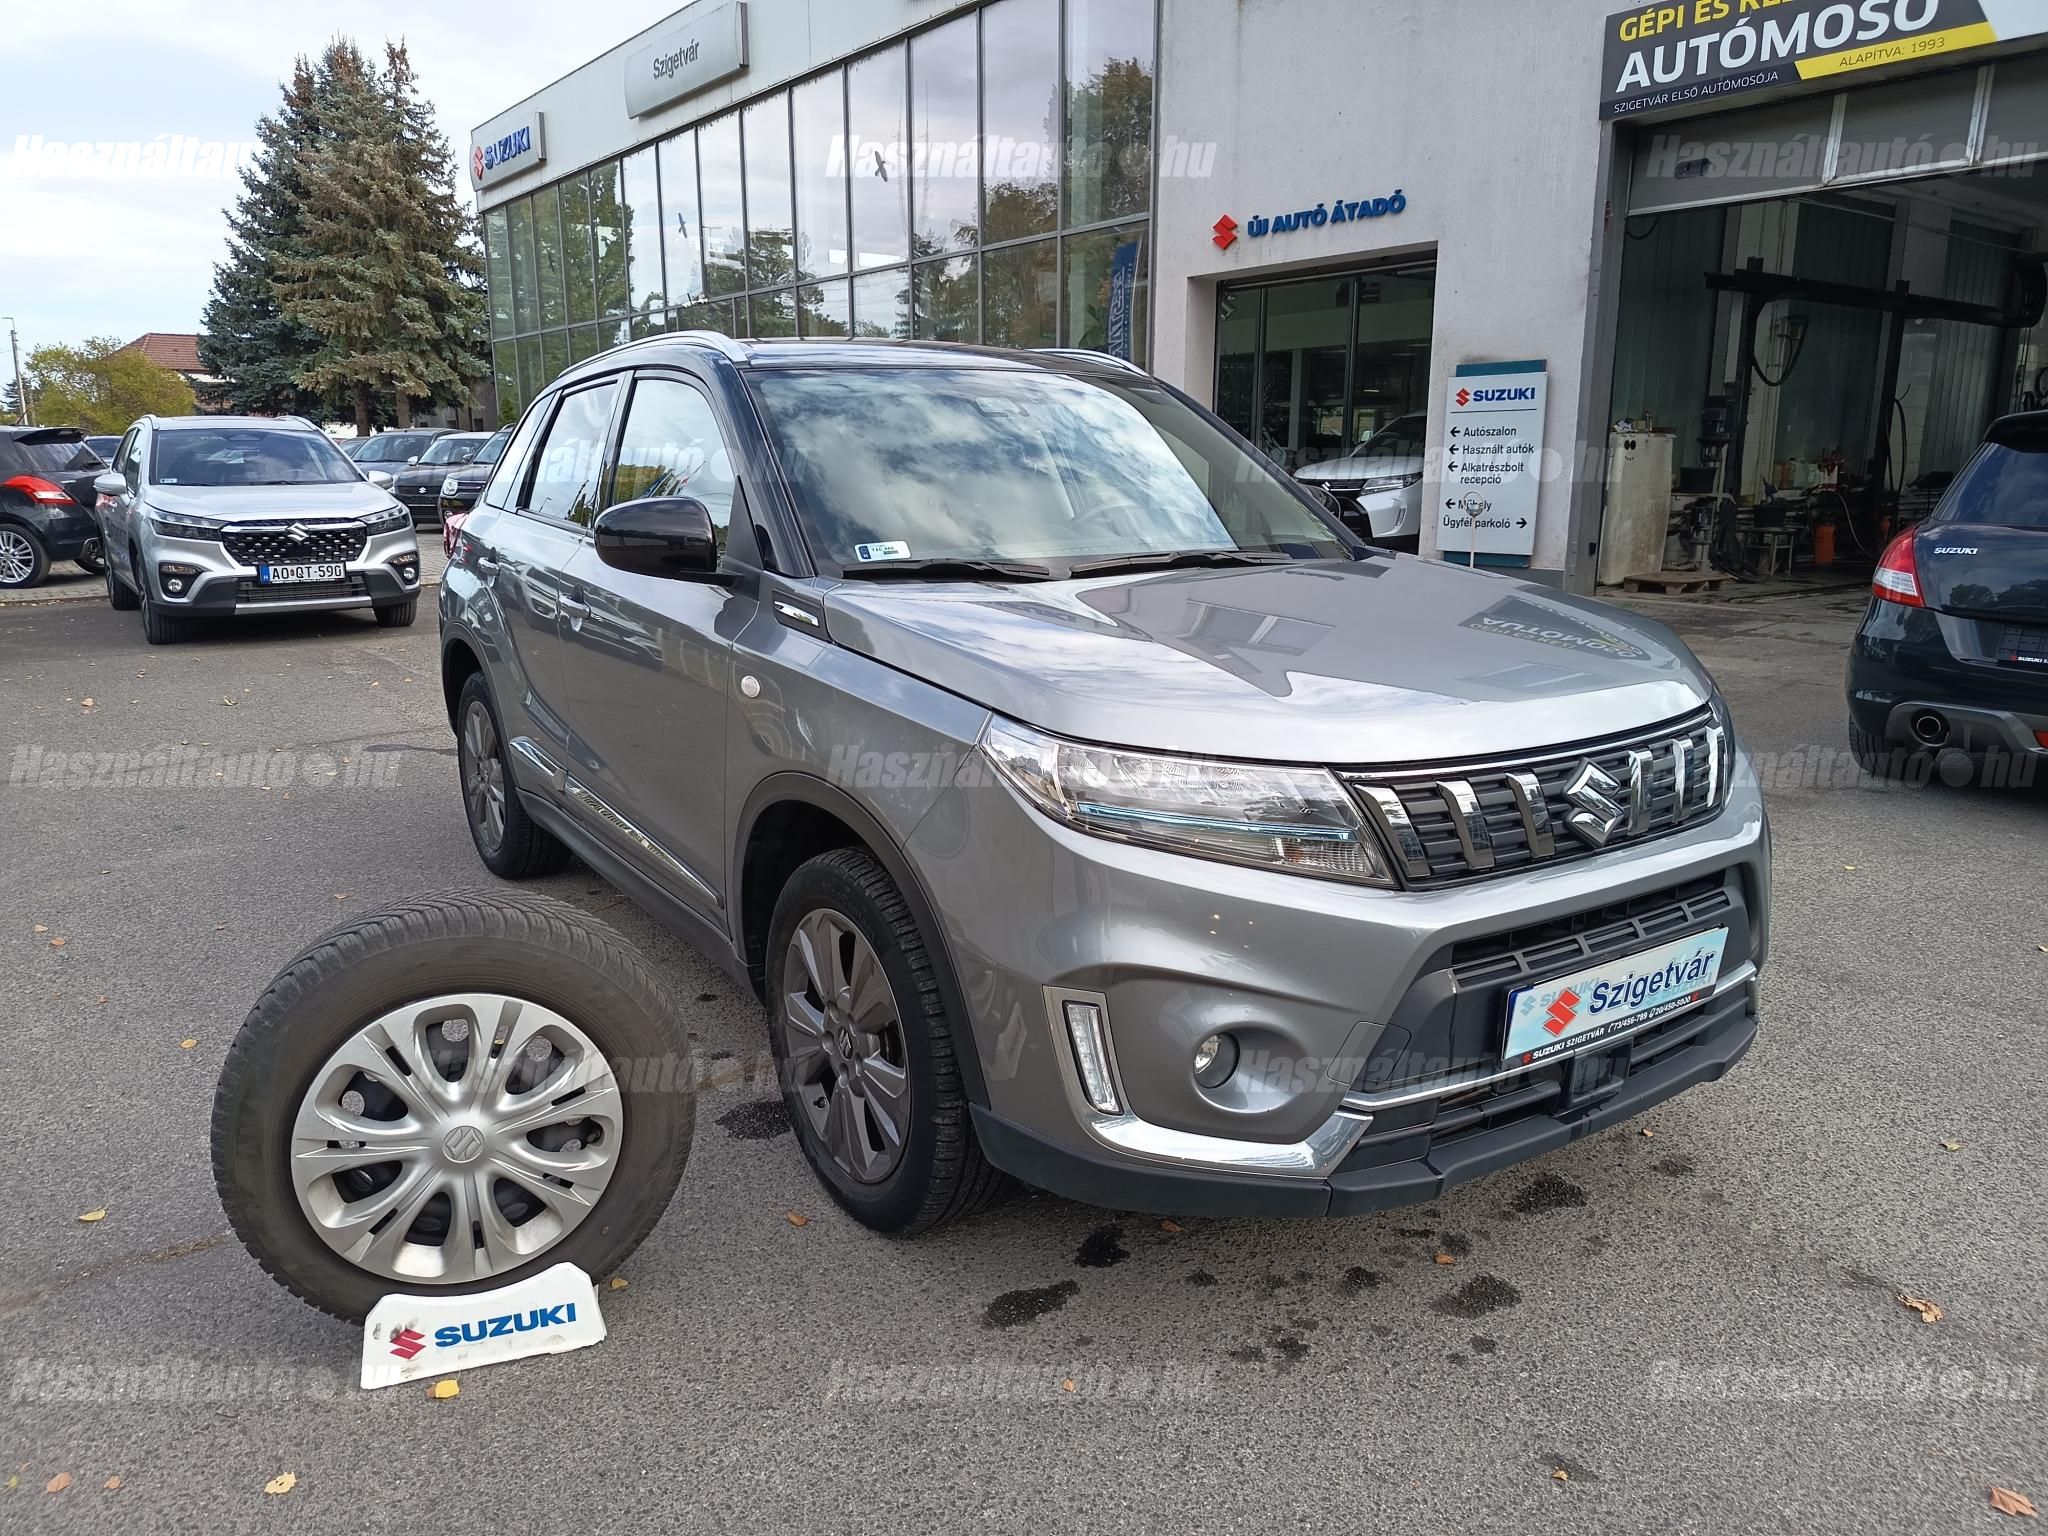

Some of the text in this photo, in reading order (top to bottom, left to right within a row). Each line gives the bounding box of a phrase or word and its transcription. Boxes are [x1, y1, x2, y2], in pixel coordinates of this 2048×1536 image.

[1619, 4, 1684, 42] GÉPI
[653, 38, 699, 80] Szigetvár
[1839, 37, 1946, 67] ALAPÍTVA: 1993
[1614, 93, 1668, 113] SZIGETVÁR
[1701, 71, 1778, 95] AUTÓMOSÓJA
[485, 126, 531, 170] SUZUKI
[1248, 189, 1406, 237] ÚJ AUTÓ ÁTADÓ
[1473, 387, 1536, 402] SUZUKI
[1463, 426, 1517, 437] Autószalon
[1462, 443, 1534, 455] Használt autók
[1460, 462, 1524, 472] Alkatrészbolt
[1460, 474, 1501, 485] recepció
[1443, 515, 1511, 529] Ügyfél parkoló
[1934, 547, 1978, 555] SUZUKI
[1588, 947, 1716, 1015] Szigetvár
[1532, 1042, 1565, 1059] SUZUKI
[1566, 1027, 1605, 1047] SZIGETVÁR
[435, 1303, 576, 1347] SUZUKI
